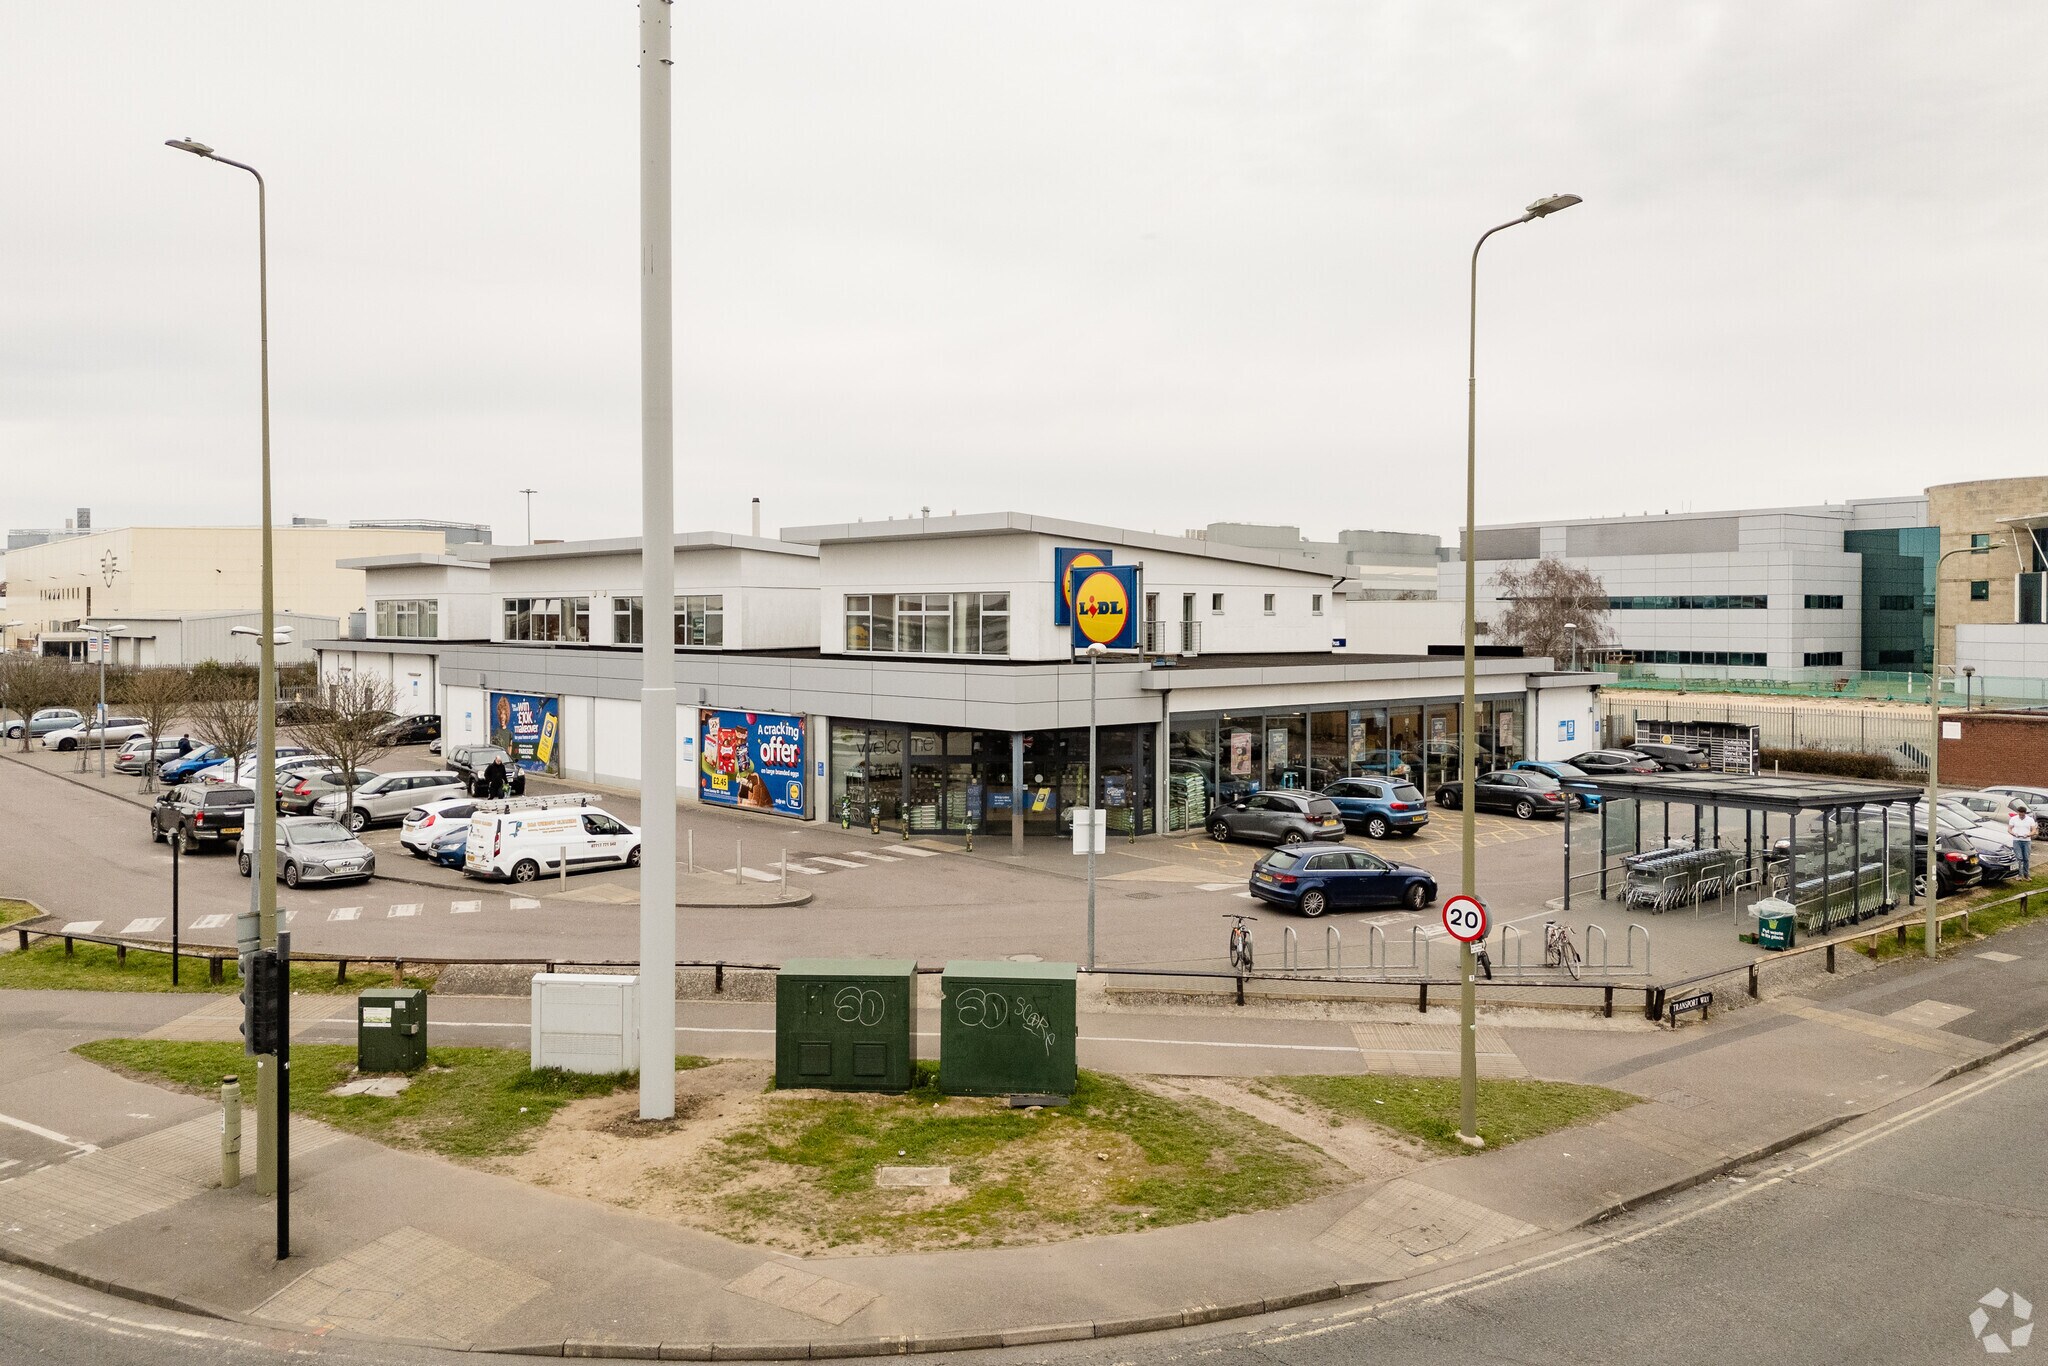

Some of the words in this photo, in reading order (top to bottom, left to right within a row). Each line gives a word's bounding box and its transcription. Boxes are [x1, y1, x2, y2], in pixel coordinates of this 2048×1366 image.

[514, 724, 539, 734] makeover
[757, 725, 764, 735] A
[764, 721, 799, 741] cracking
[760, 736, 798, 763] offer
[713, 777, 727, 787] £2.45
[775, 769, 790, 777] branded
[790, 771, 799, 779] eggs
[1450, 908, 1478, 929] 20
[1673, 998, 1699, 1012] TRANSPORT
[1700, 995, 1710, 1004] WAY
